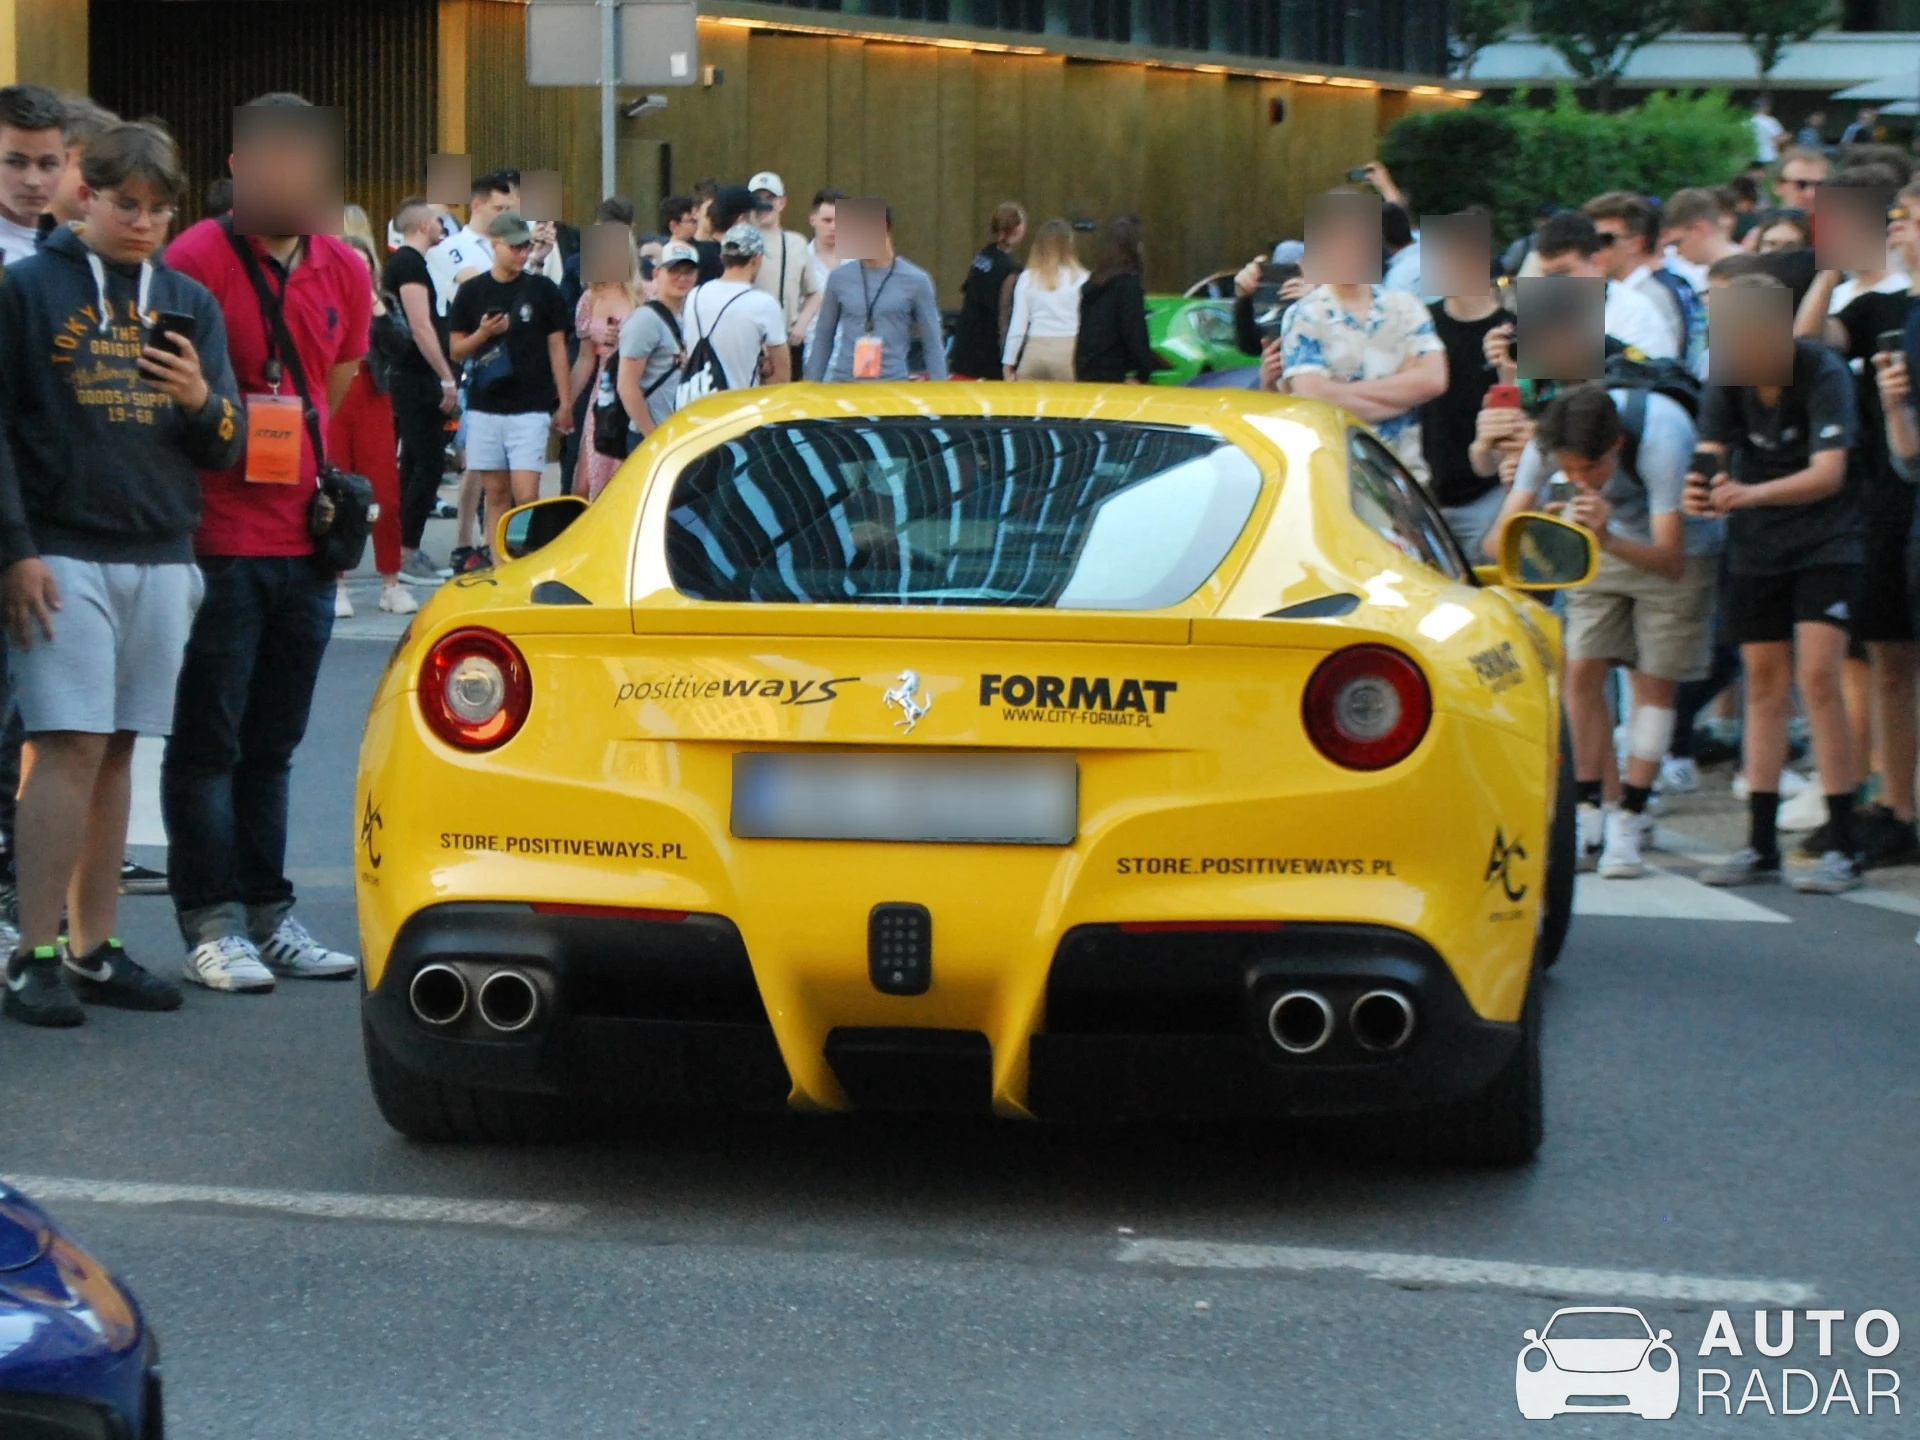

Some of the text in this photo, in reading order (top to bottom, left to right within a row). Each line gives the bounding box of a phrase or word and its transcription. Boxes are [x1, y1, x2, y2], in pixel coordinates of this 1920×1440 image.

[449, 249, 463, 264] 3
[111, 326, 140, 342] THE
[89, 340, 143, 358] ORIGIN
[613, 674, 861, 708] positiveways
[979, 673, 1178, 714] FORMAT
[1003, 708, 1153, 728] WWW.CITY-FORMAT.PL
[440, 833, 688, 860] STORE.POSITIVEWAYS.PL
[1116, 857, 1397, 876] STORE.POSITIVEWAYS.PL
